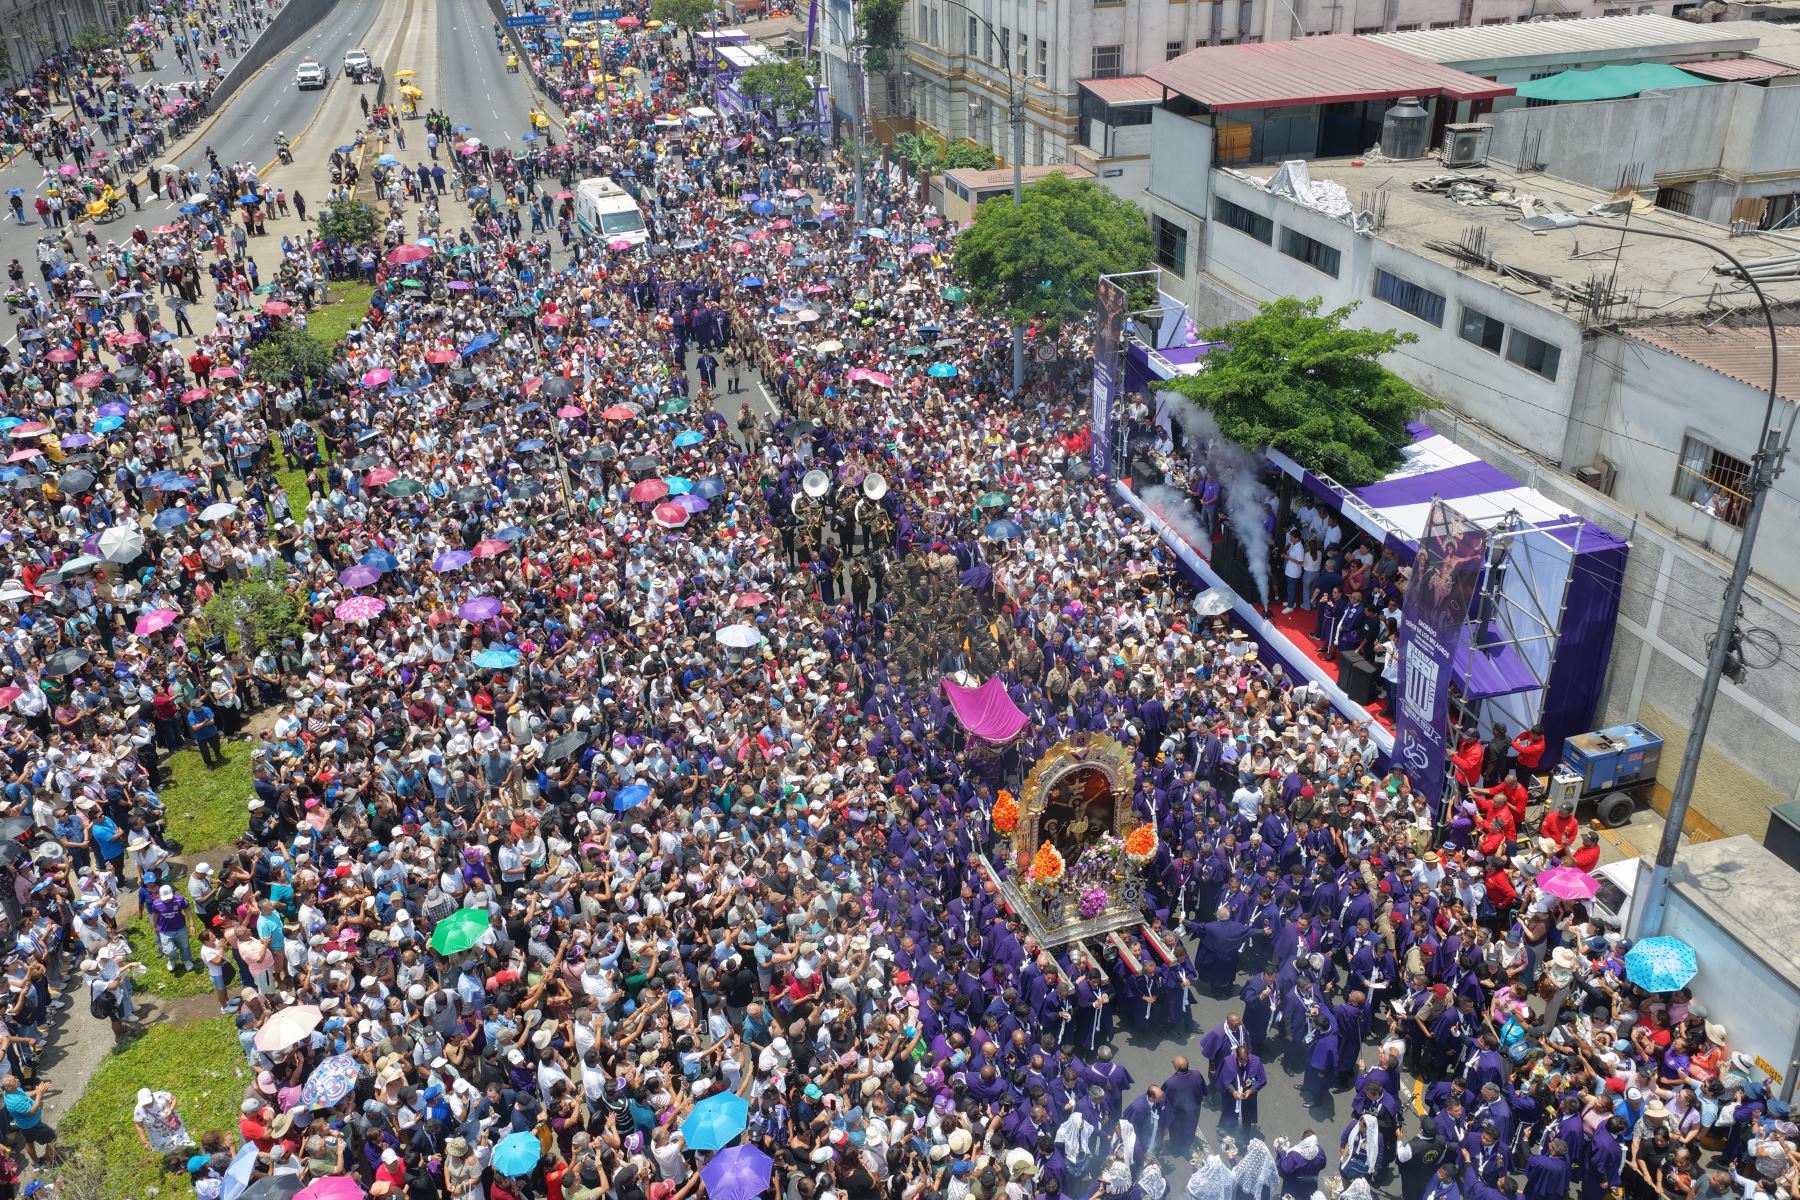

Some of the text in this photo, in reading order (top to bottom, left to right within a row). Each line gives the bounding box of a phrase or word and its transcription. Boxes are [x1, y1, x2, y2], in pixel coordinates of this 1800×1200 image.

[1041, 346, 1052, 355] 30
[1421, 631, 1430, 641] LOS
[1429, 637, 1450, 659] MILAGROS
[1403, 728, 1429, 768] 125
